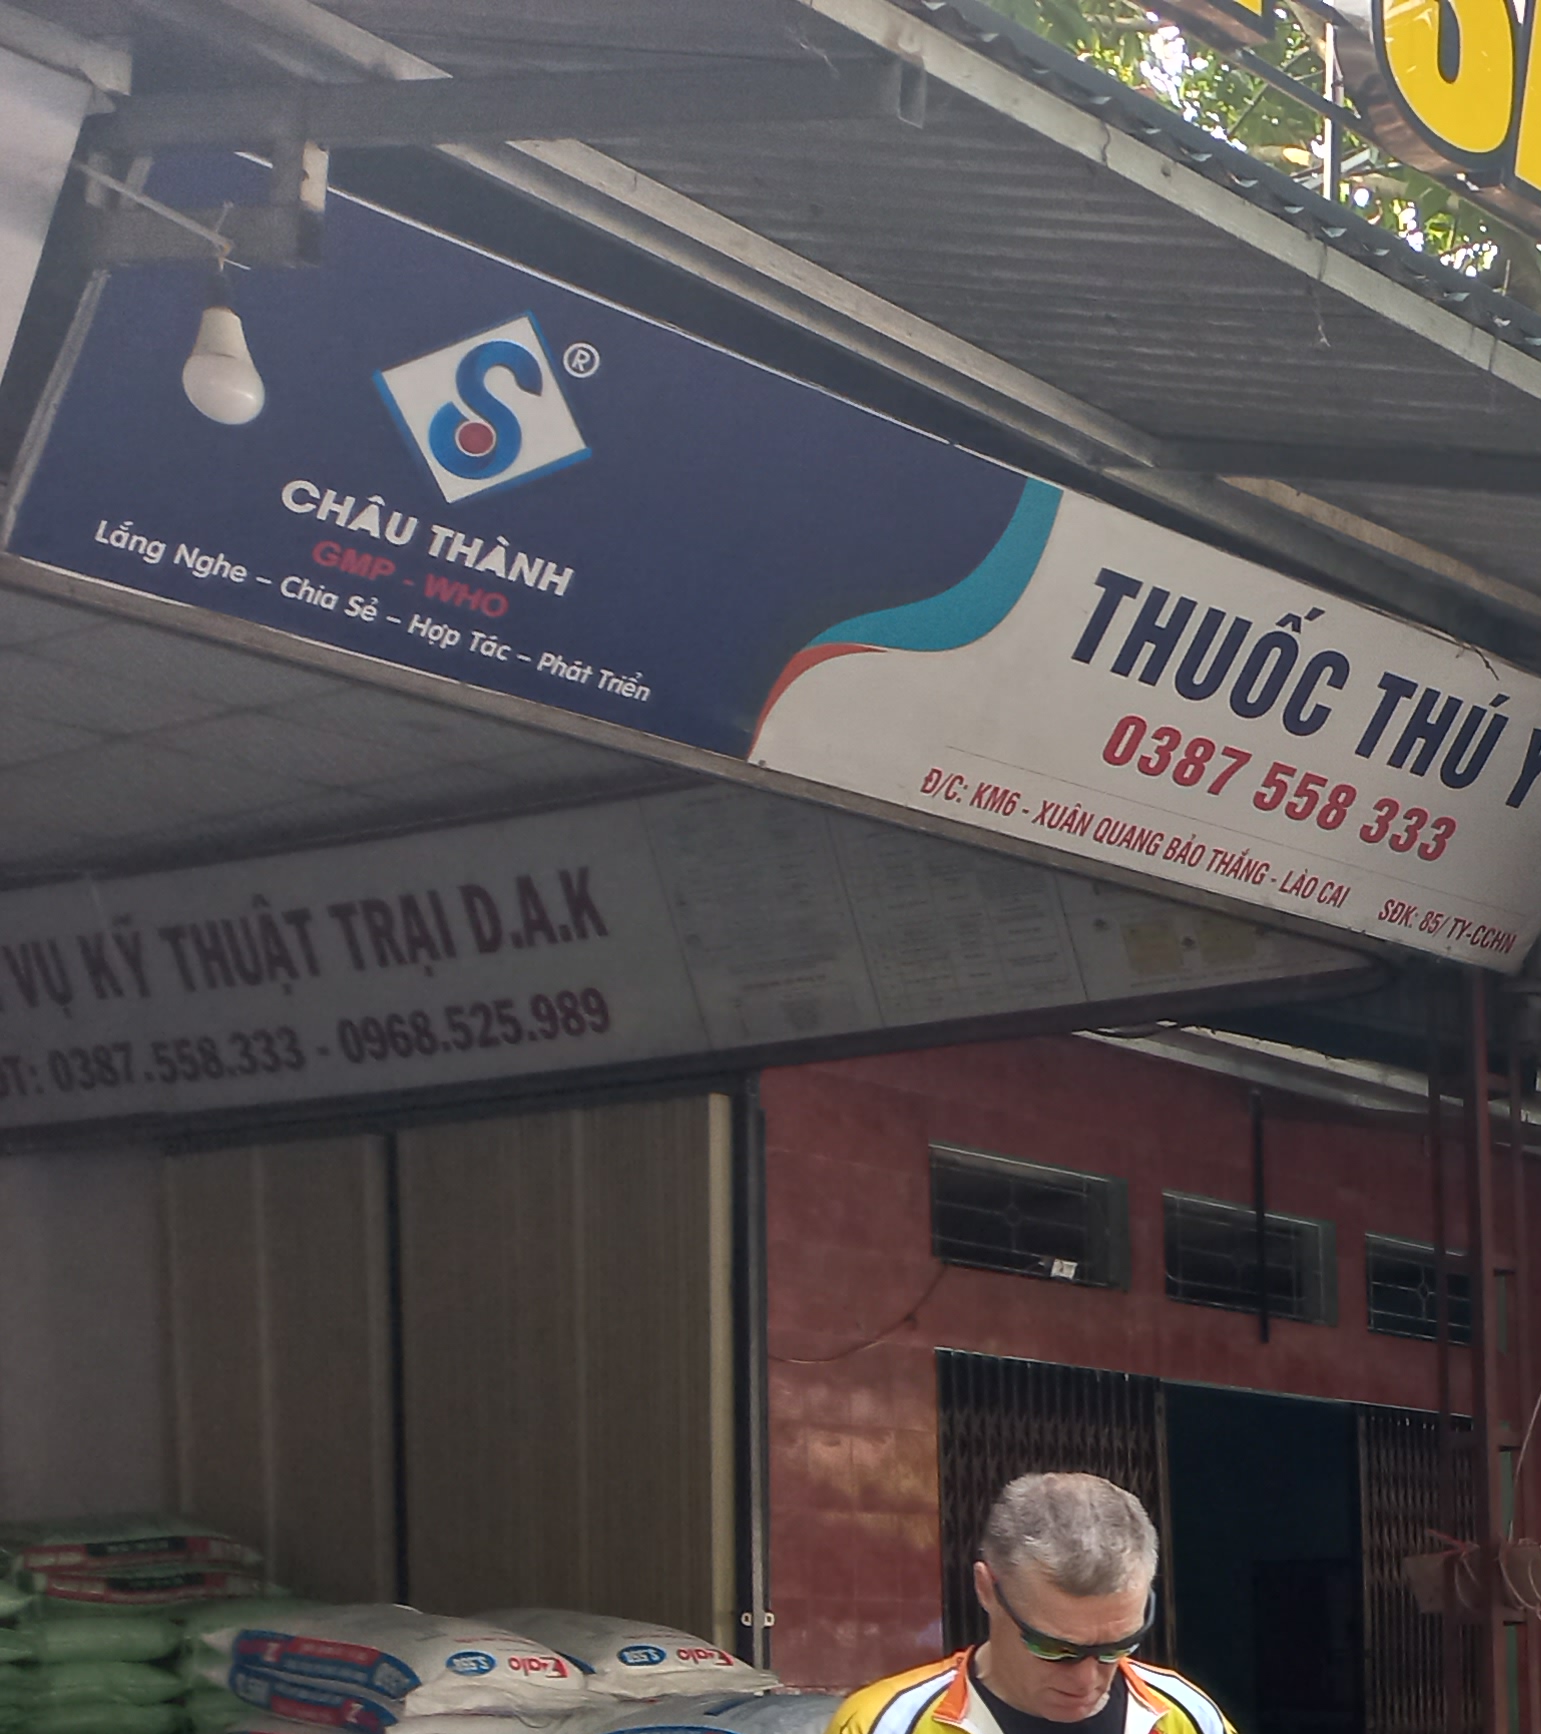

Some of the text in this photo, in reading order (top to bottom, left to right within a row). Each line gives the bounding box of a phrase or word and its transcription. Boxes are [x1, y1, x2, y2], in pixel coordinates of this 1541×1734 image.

[281, 478, 576, 597] CHÂU THÀNH
[313, 540, 396, 586] GMP
[425, 573, 508, 618] WHO
[95, 520, 166, 564] Lắng
[174, 543, 248, 587] Nghe
[280, 574, 338, 612] Chia
[344, 590, 379, 624] Sẻ
[407, 613, 462, 651] Hợp
[469, 628, 512, 663] Tác
[537, 651, 592, 686] Phát
[597, 666, 652, 703] Triển
[1071, 567, 1351, 737] THUỐC
[1355, 670, 1511, 791] THÚ
[922, 767, 968, 804] Đ/C:
[969, 781, 1017, 819] KM6
[1031, 797, 1088, 837] XUÂN
[1092, 817, 1161, 858] QUANG
[1162, 829, 1201, 869] BẢO
[1203, 844, 1270, 887] THẮNG
[1278, 863, 1318, 902] LÀO
[1316, 878, 1350, 911] CAI
[1101, 714, 1457, 863] 0387 558 333
[76, 913, 150, 999] KỸ
[157, 893, 320, 996] THUẬT
[328, 889, 456, 980] TRẠI
[458, 867, 609, 954] D.A.K
[49, 1026, 306, 1092] 0387.558.333
[336, 986, 610, 1064] 0968.525.989
